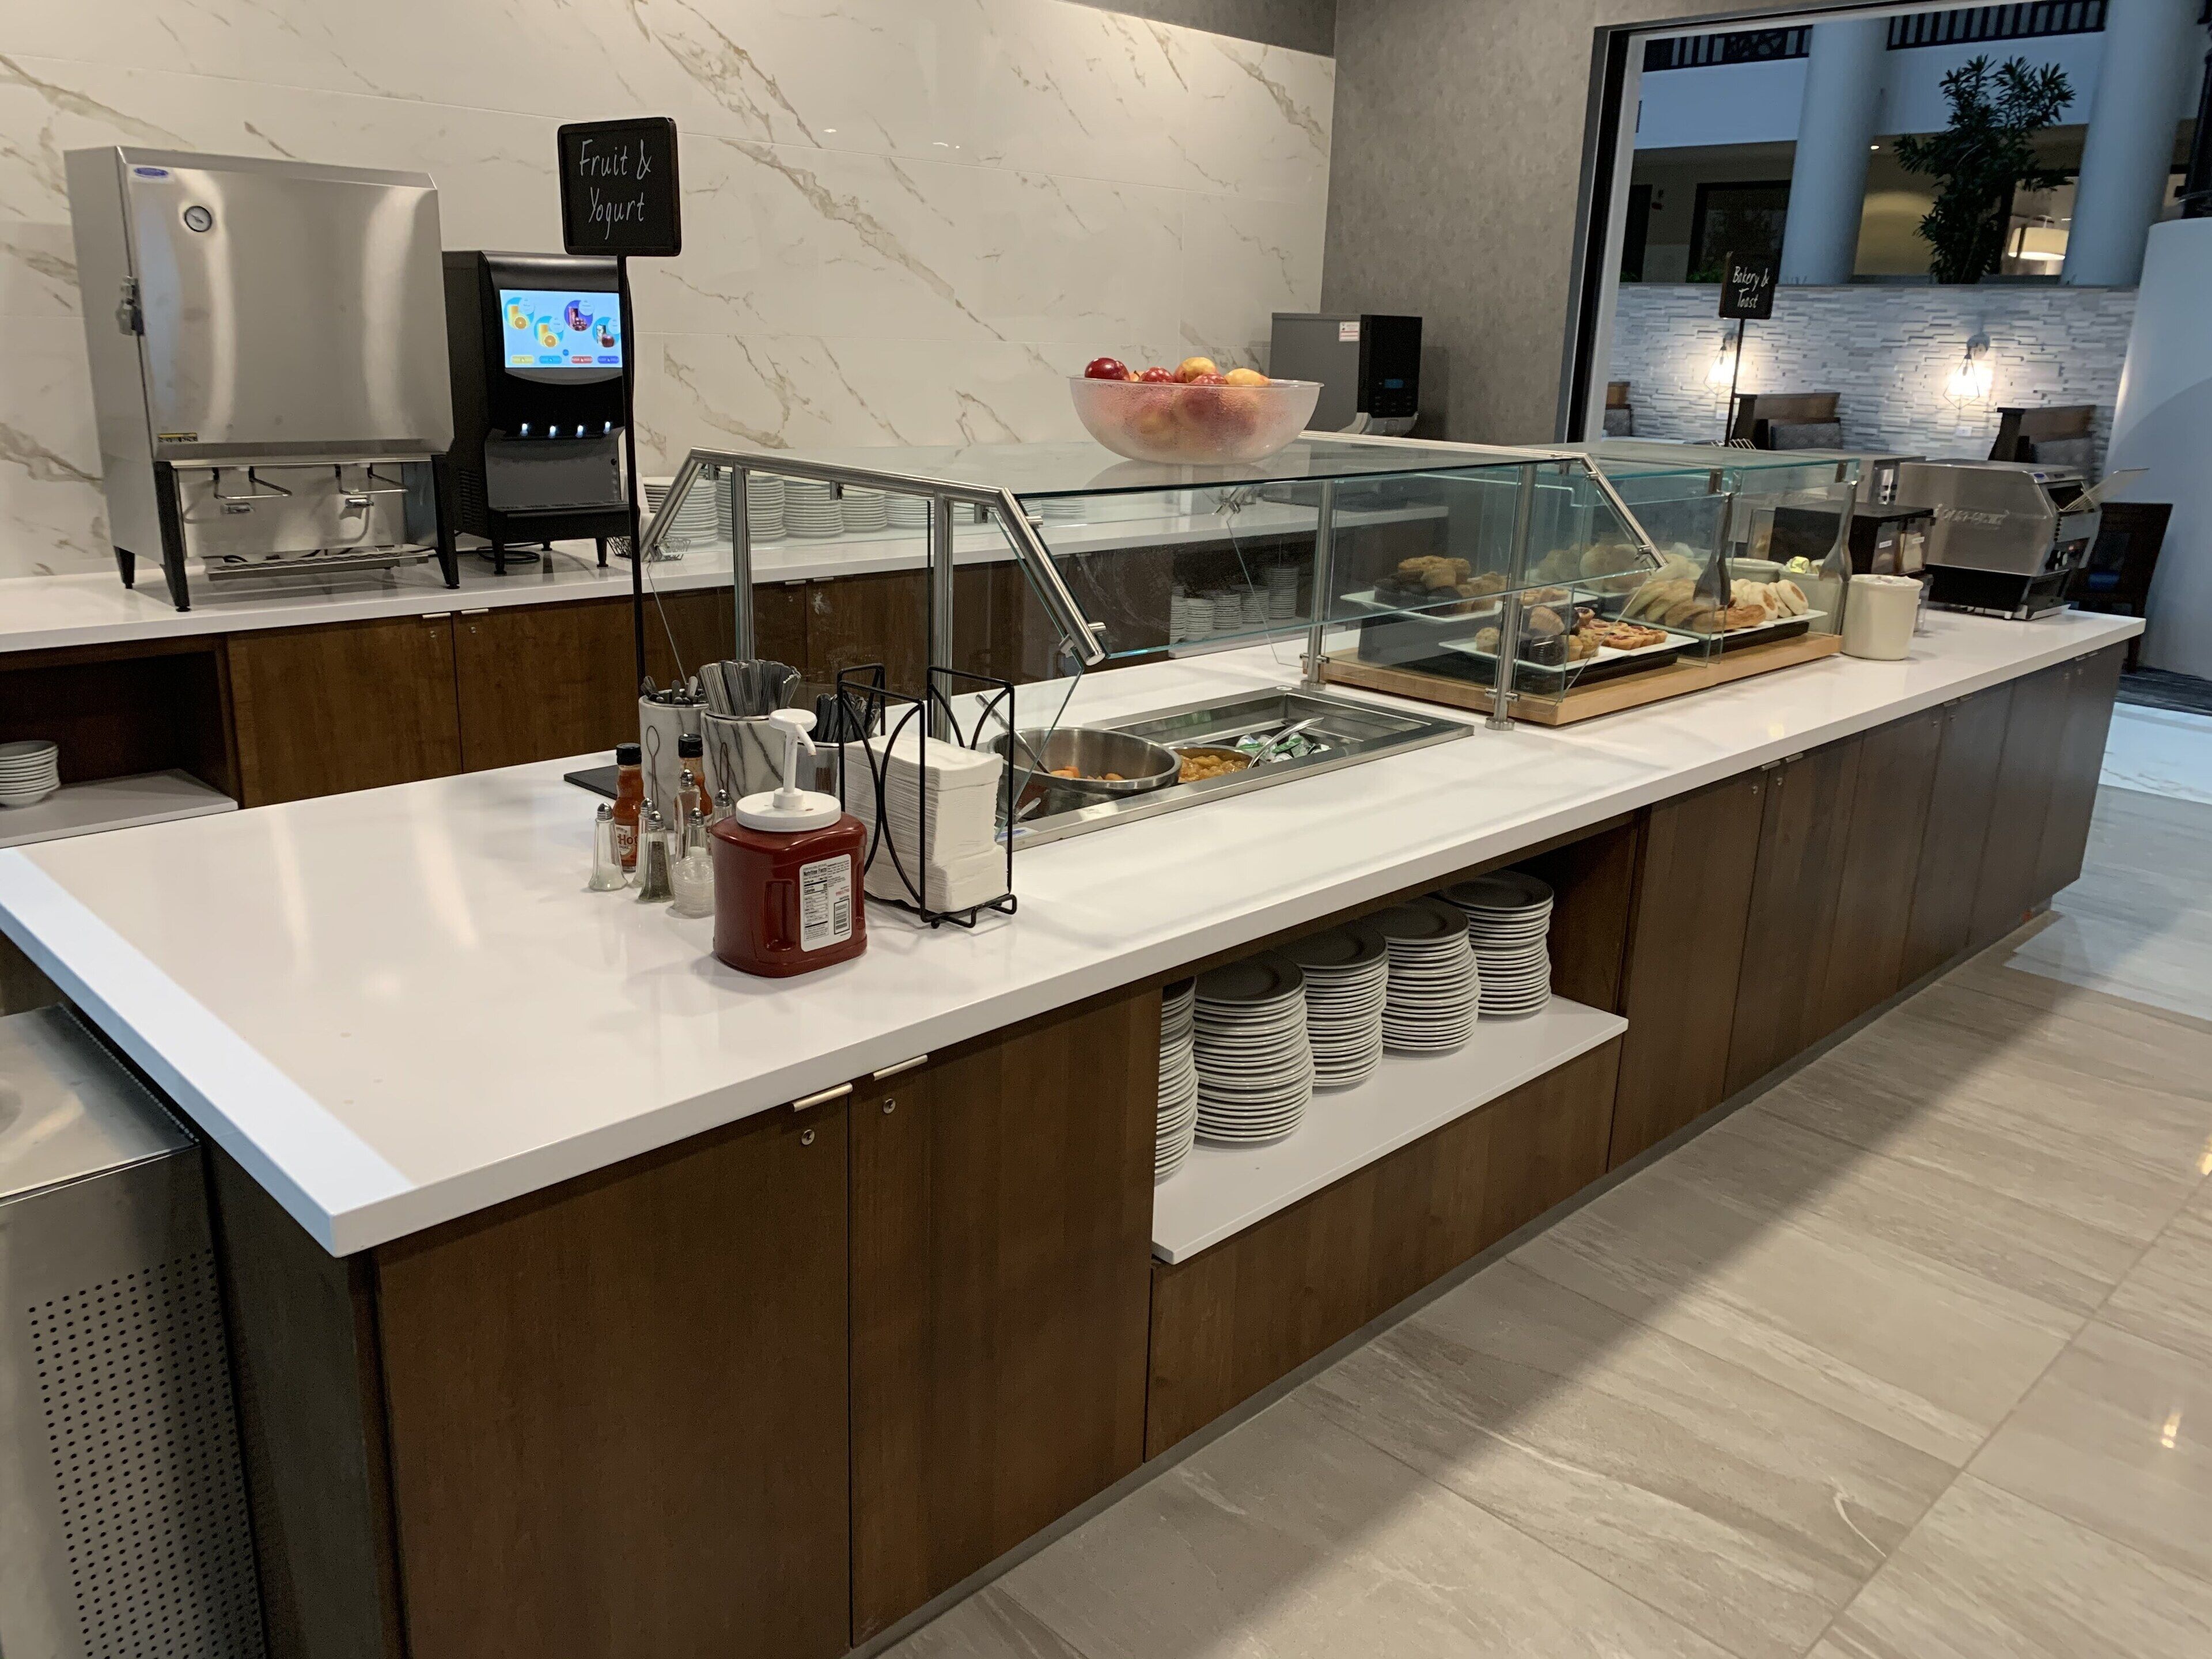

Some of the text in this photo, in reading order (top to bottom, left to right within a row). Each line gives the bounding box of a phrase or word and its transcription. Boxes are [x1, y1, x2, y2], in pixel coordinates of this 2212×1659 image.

[579, 138, 652, 180] Fruit &
[588, 187, 645, 240] Yogurt
[1732, 266, 1770, 292] Bakery &
[1737, 287, 1759, 308] Toast
